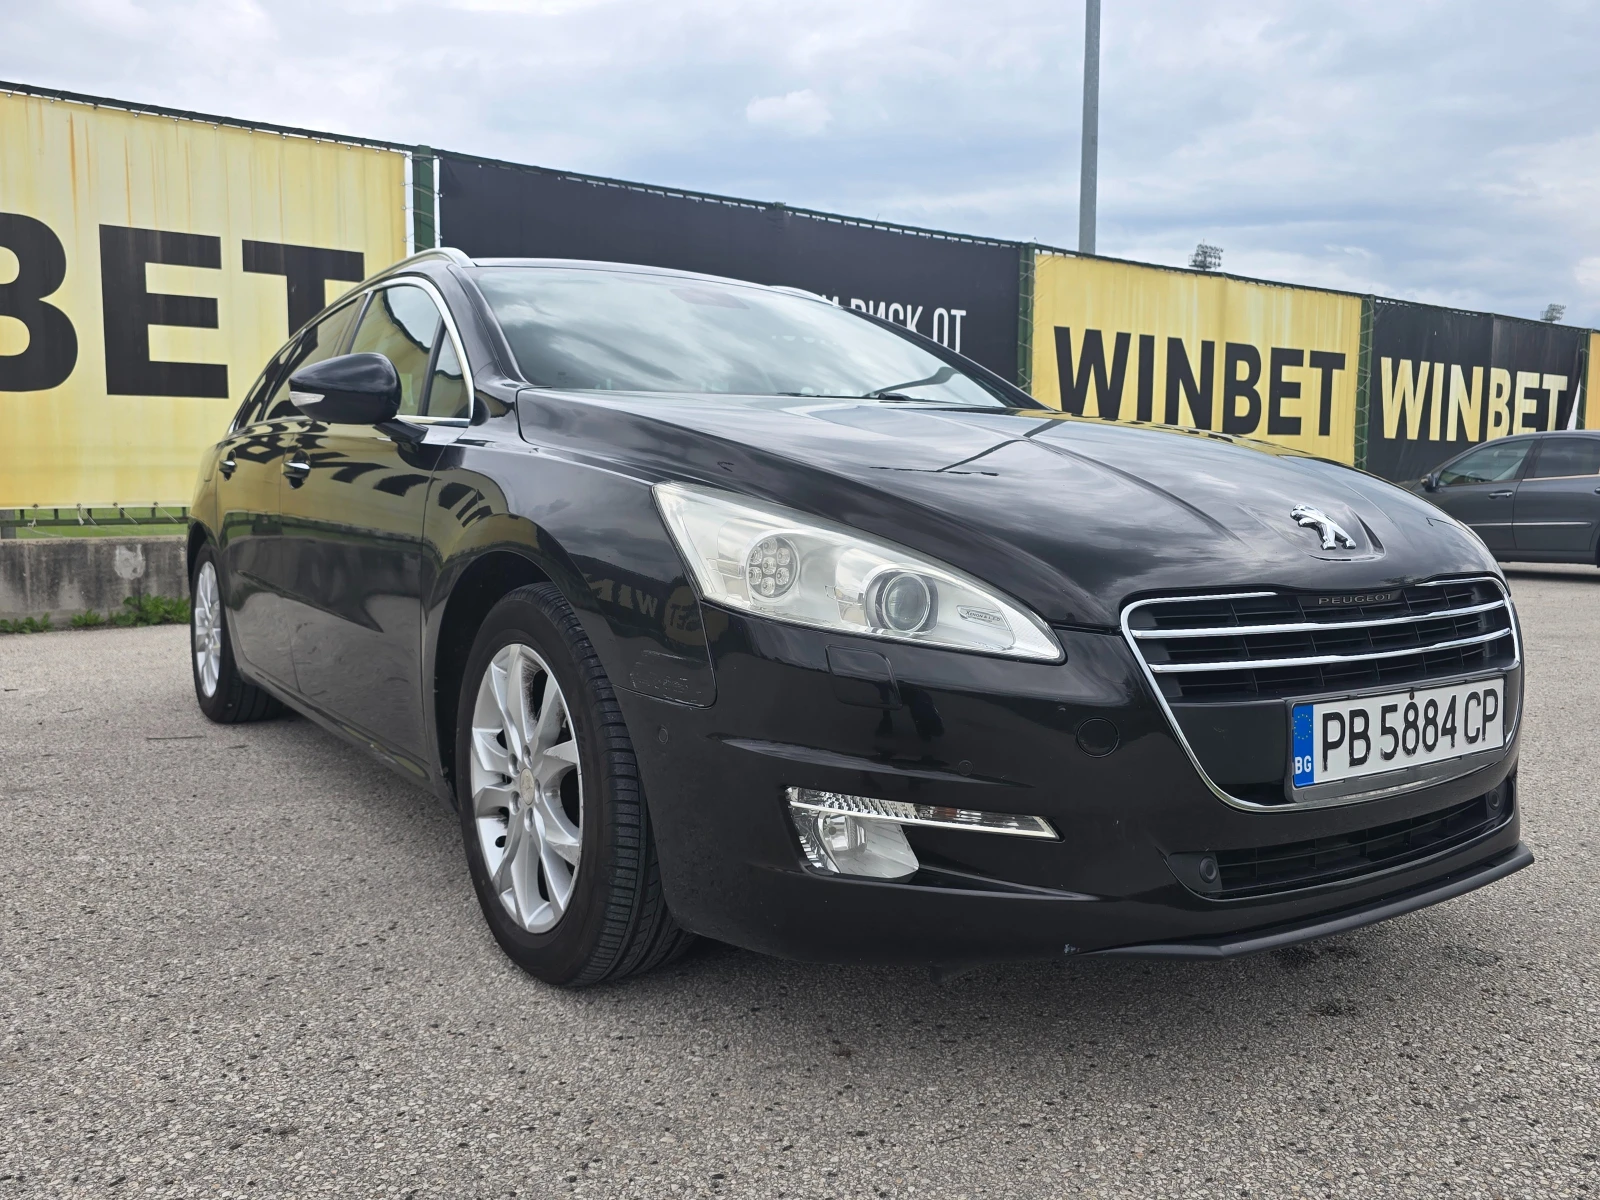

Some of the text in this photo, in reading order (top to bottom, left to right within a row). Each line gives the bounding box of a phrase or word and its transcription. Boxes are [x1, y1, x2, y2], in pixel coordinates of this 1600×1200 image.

[1053, 326, 1347, 437] WINBET
[1380, 356, 1568, 442] WINBET
[1318, 593, 1392, 605] PEUGEOT
[1294, 755, 1312, 775] BG
